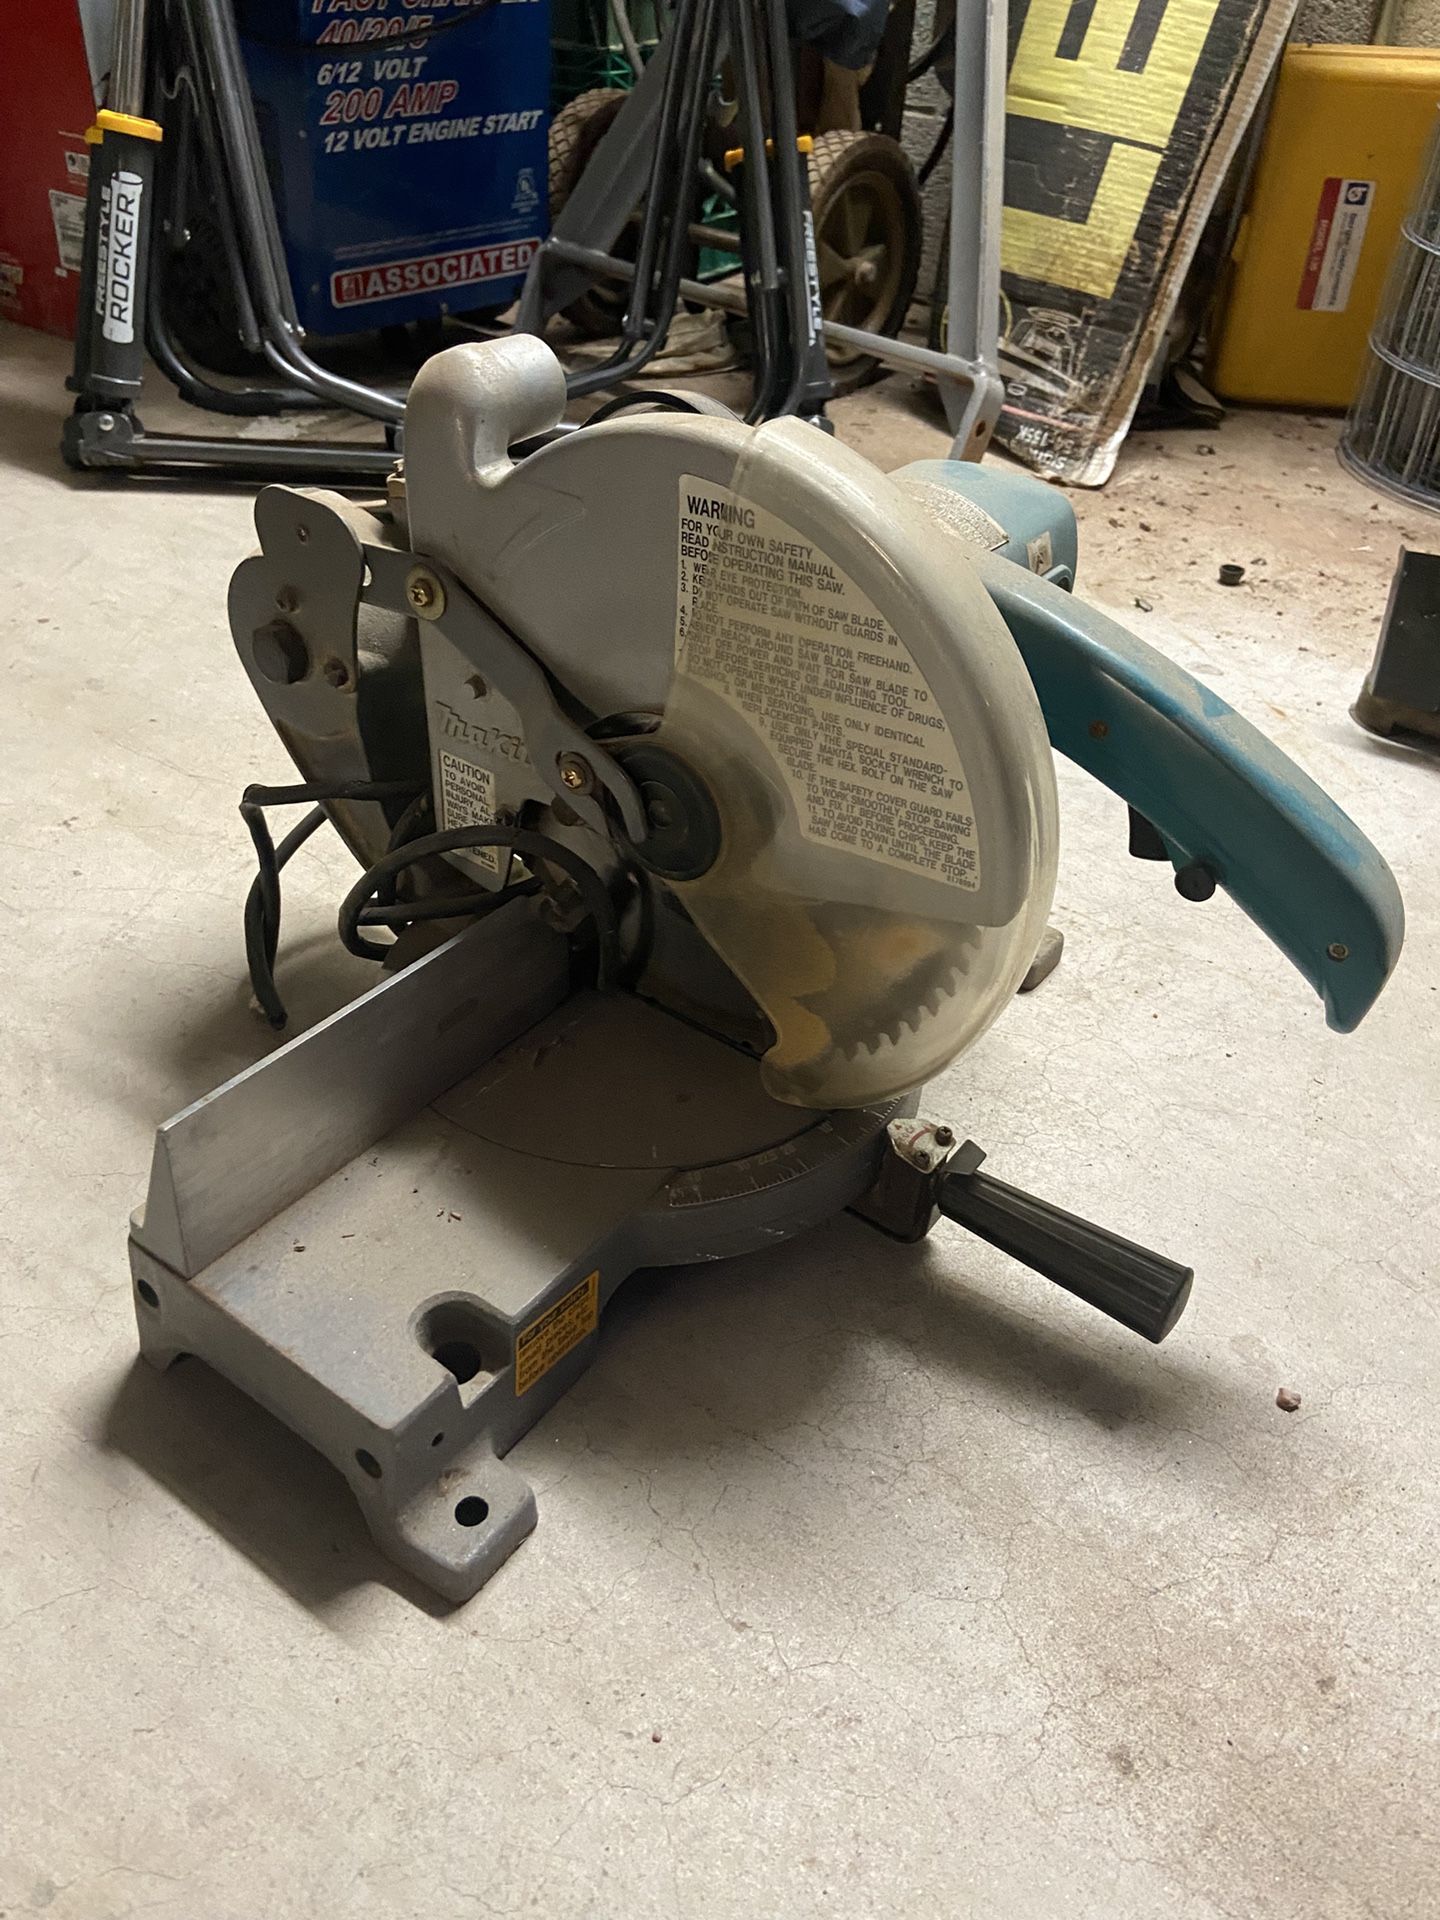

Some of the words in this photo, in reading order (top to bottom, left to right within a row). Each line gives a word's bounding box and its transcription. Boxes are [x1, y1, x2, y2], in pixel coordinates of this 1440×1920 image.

[317, 61, 362, 86] 6/12
[373, 55, 429, 81] VOLT
[319, 86, 385, 126] 200
[382, 79, 460, 119] AMP
[324, 130, 350, 154] 12
[353, 124, 408, 150] VOLT
[406, 116, 483, 144] ENGINE
[482, 109, 544, 135] START
[95, 184, 113, 317] FREESTYLE
[109, 192, 136, 324] ROCKER
[365, 242, 534, 297] ASSOCIATED
[687, 494, 756, 529] WARNING
[681, 517, 703, 534] FOR
[706, 523, 733, 541] YOUR
[737, 532, 765, 549] OWN
[768, 539, 814, 559] SAFETY
[681, 531, 710, 548] READ
[712, 540, 784, 568] INSTRUCTION
[788, 557, 836, 580] MANUAL
[681, 544, 720, 566] BEFORE
[722, 556, 785, 581] OPERATING
[787, 571, 813, 588] THIS
[816, 577, 846, 596] SAW.
[720, 570, 737, 583] EYE
[715, 580, 746, 597] HANDS
[748, 588, 769, 602] OUT
[771, 594, 784, 606] OF
[786, 598, 810, 613] PATH
[811, 604, 825, 616] OF
[828, 607, 849, 621] SAW
[850, 613, 887, 632] BLADE.
[726, 594, 768, 615] OPERATE
[770, 605, 792, 620] SAW
[794, 612, 840, 632] WITHOUT
[842, 623, 884, 643] GUARDS
[887, 634, 898, 647] IN
[720, 627, 752, 644] REACH
[754, 638, 794, 656] AROUND
[798, 647, 820, 662] SAW
[823, 655, 857, 673] BLADE.
[728, 619, 772, 639] PERFORM
[775, 631, 794, 645] ANY
[798, 637, 853, 659] OPERATION
[857, 651, 913, 675] FREEHAND.
[737, 643, 770, 662] POWER
[773, 654, 794, 667] AND
[798, 660, 821, 675] WAIT
[825, 667, 845, 681] FOR
[849, 672, 872, 688] SAW
[875, 680, 910, 697] BLADE
[913, 688, 929, 702] TO
[752, 659, 801, 682] SERVICING
[804, 673, 820, 686] OR
[823, 679, 877, 702] ADJUSTING
[881, 692, 913, 710] TOOL.
[799, 682, 832, 700] UNDER
[834, 692, 888, 715] INFLUENCE
[890, 706, 905, 720] OF
[907, 711, 946, 733] DRUGS,
[793, 725, 819, 741] ONLY
[823, 733, 841, 748] THE
[845, 739, 886, 760] SPECIAL
[889, 751, 949, 775] STANDARD-
[821, 710, 841, 725] USE
[844, 717, 871, 733] ONLY
[874, 724, 926, 749] IDENTICAL
[443, 754, 490, 785] CAUTION
[444, 768, 456, 781] TO
[460, 777, 486, 795] AVOID
[445, 779, 490, 807] PERSONAL
[816, 752, 834, 767] THE
[861, 765, 886, 781] BOLT
[889, 773, 904, 786] ON
[907, 777, 928, 793] THE
[930, 785, 954, 800] SAW
[819, 743, 853, 761] MAKITA
[859, 754, 899, 774] SOCKET
[903, 765, 945, 787] WRENCH
[949, 778, 964, 792] TO
[806, 782, 819, 795] TO
[821, 786, 849, 802] WORK
[904, 810, 931, 825] STOP
[933, 818, 972, 838] SAWING
[806, 794, 825, 806] AND
[828, 799, 843, 811] FIX
[846, 804, 856, 814] IT
[859, 807, 895, 827] BEFORE
[897, 818, 960, 846] PROCEEDING.
[808, 773, 817, 784] IF
[819, 775, 838, 789] THE
[839, 781, 875, 799] SAFETY
[876, 791, 908, 809] COVER
[909, 801, 943, 819] GUARD
[945, 811, 973, 828] FAILS
[808, 824, 827, 838] HAS
[830, 830, 857, 846] COME
[861, 838, 874, 850] TO
[876, 843, 884, 854] A
[887, 847, 937, 870] COMPLETE
[940, 863, 969, 880] STOP.
[811, 815, 831, 829] SAW
[833, 820, 858, 836] HEAD
[860, 828, 889, 845] DOWN
[891, 838, 919, 855] UNTIL
[923, 846, 942, 861] THE
[944, 853, 977, 872] BLADE
[822, 807, 835, 820] TO
[836, 812, 864, 827] AVOID
[865, 819, 896, 837] FLYING
[928, 838, 955, 853] KEEP
[955, 846, 976, 860] THE
